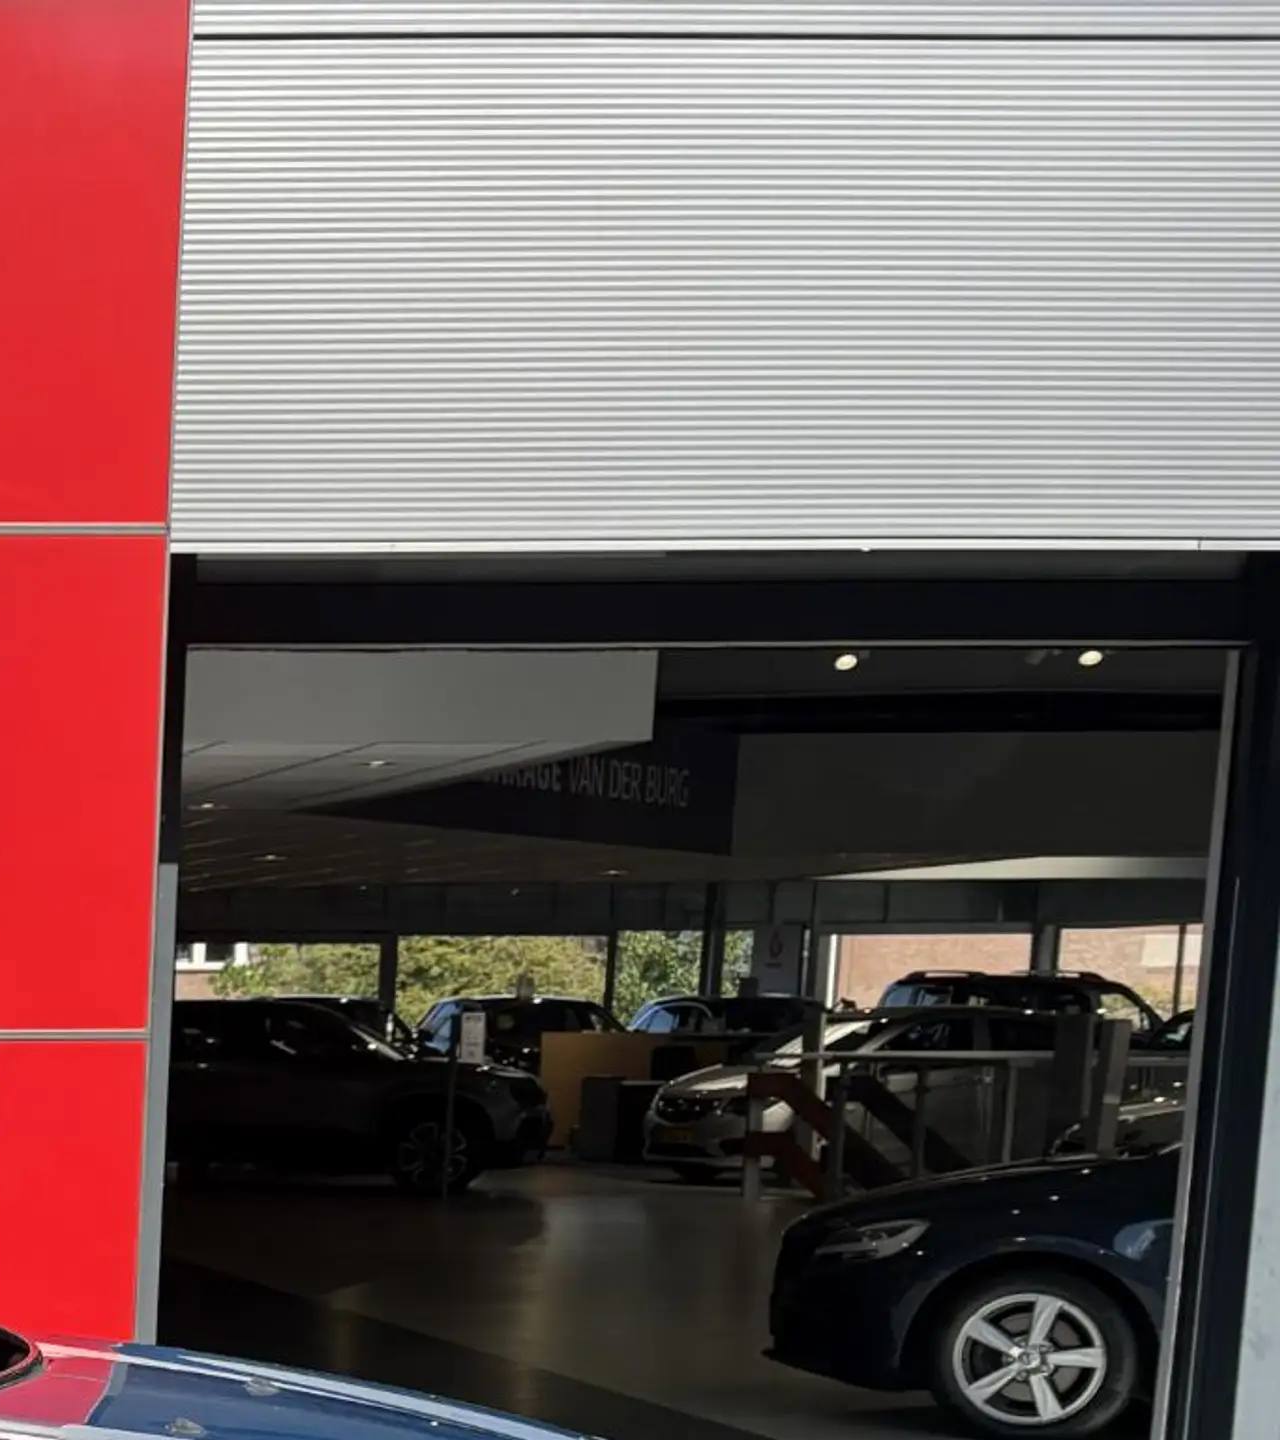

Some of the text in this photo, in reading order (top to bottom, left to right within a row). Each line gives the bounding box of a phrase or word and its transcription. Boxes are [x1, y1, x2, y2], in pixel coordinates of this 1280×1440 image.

[569, 756, 605, 797] VAN
[609, 759, 643, 803] DER
[645, 766, 690, 807] BURG
